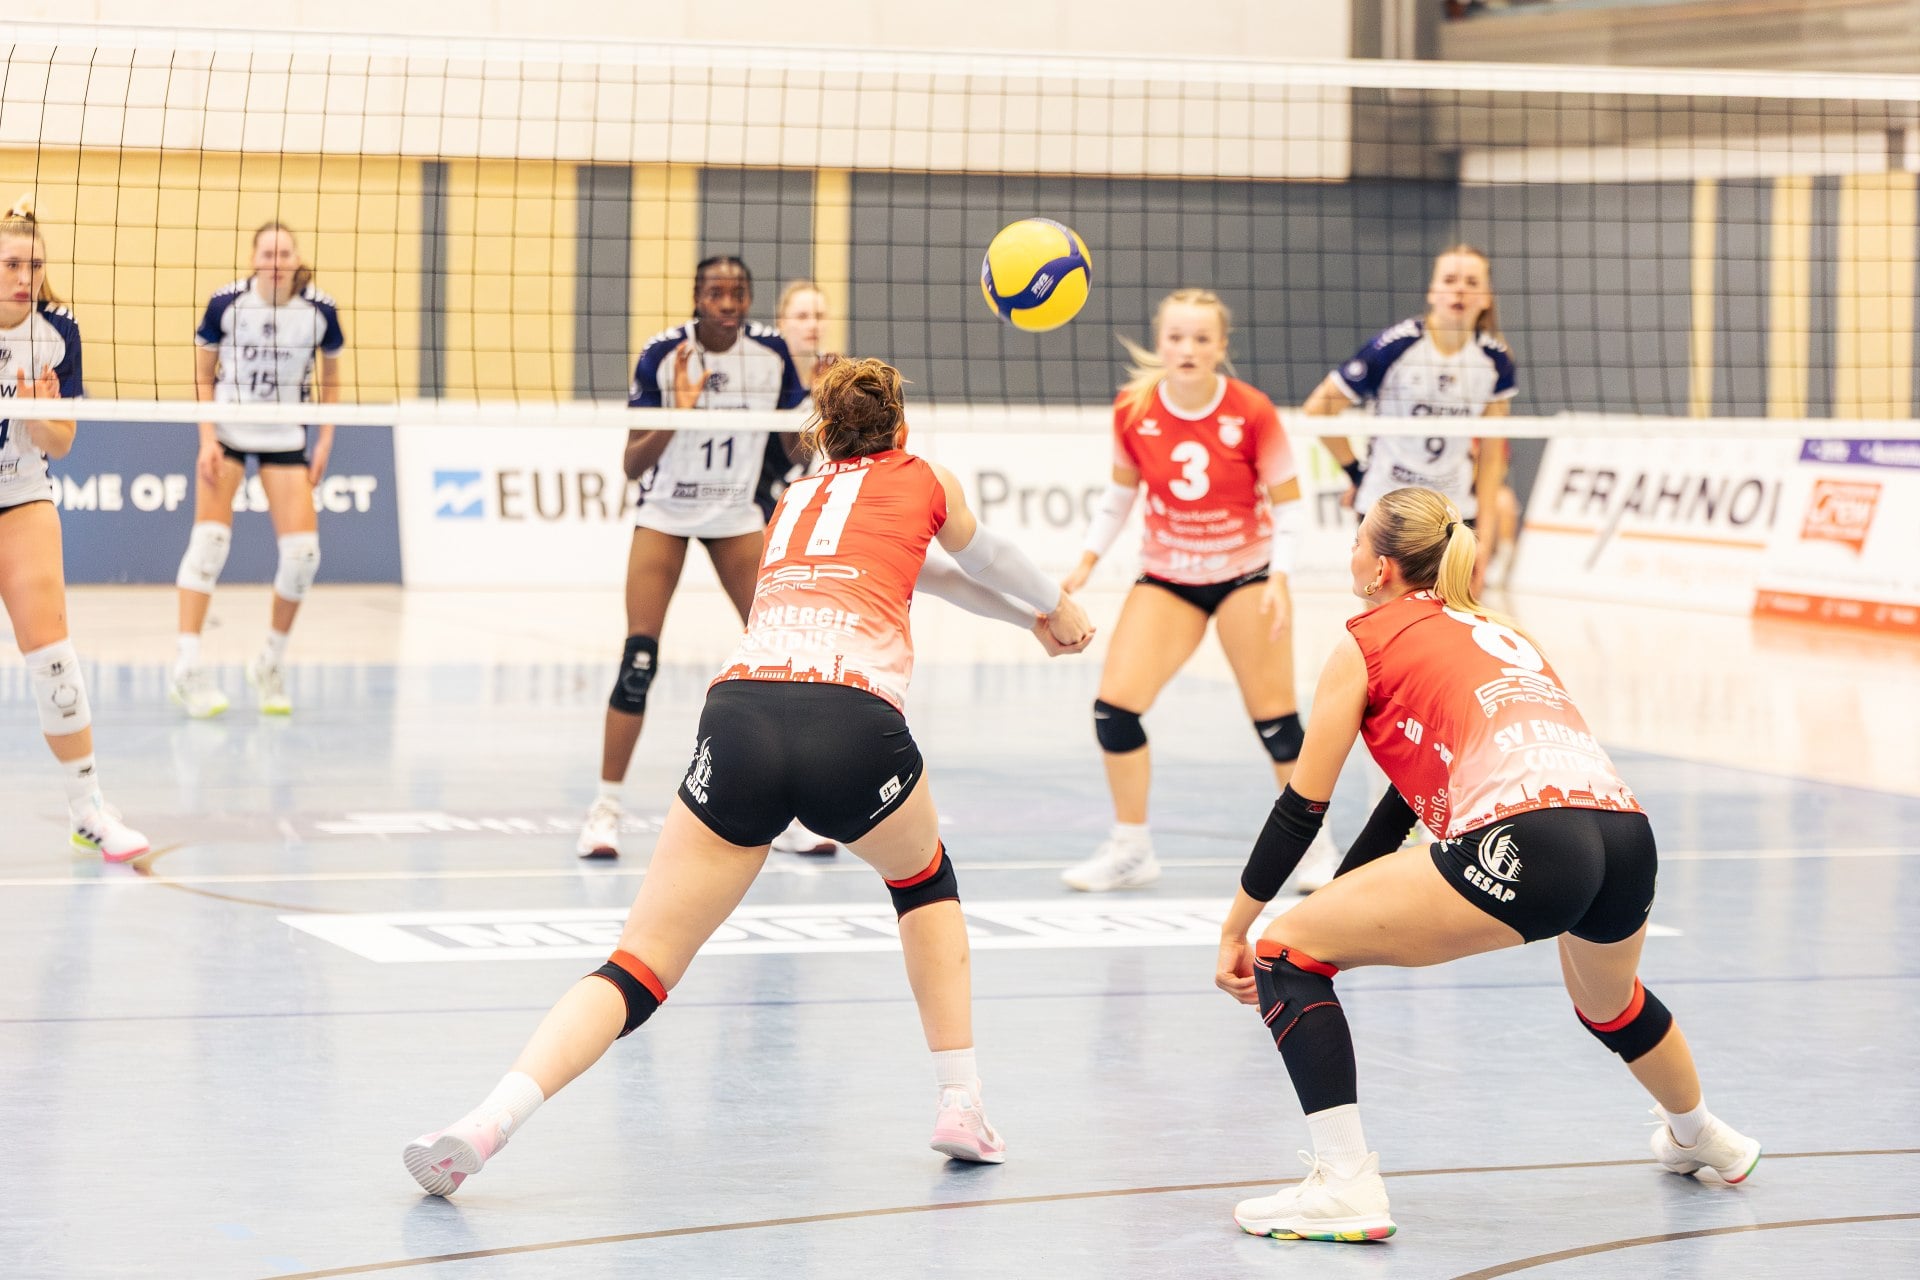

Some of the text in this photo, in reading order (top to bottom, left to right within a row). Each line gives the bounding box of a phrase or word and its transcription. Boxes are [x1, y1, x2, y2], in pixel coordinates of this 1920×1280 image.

[250, 371, 277, 397] 15
[701, 437, 733, 470] 11
[1425, 437, 1447, 463] 9
[1168, 440, 1210, 501] 3
[51, 473, 124, 511] ME
[130, 473, 188, 512] OF
[763, 468, 870, 569] 11
[1494, 719, 1602, 755] SV ENERGI
[1463, 864, 1517, 903] GESAP
